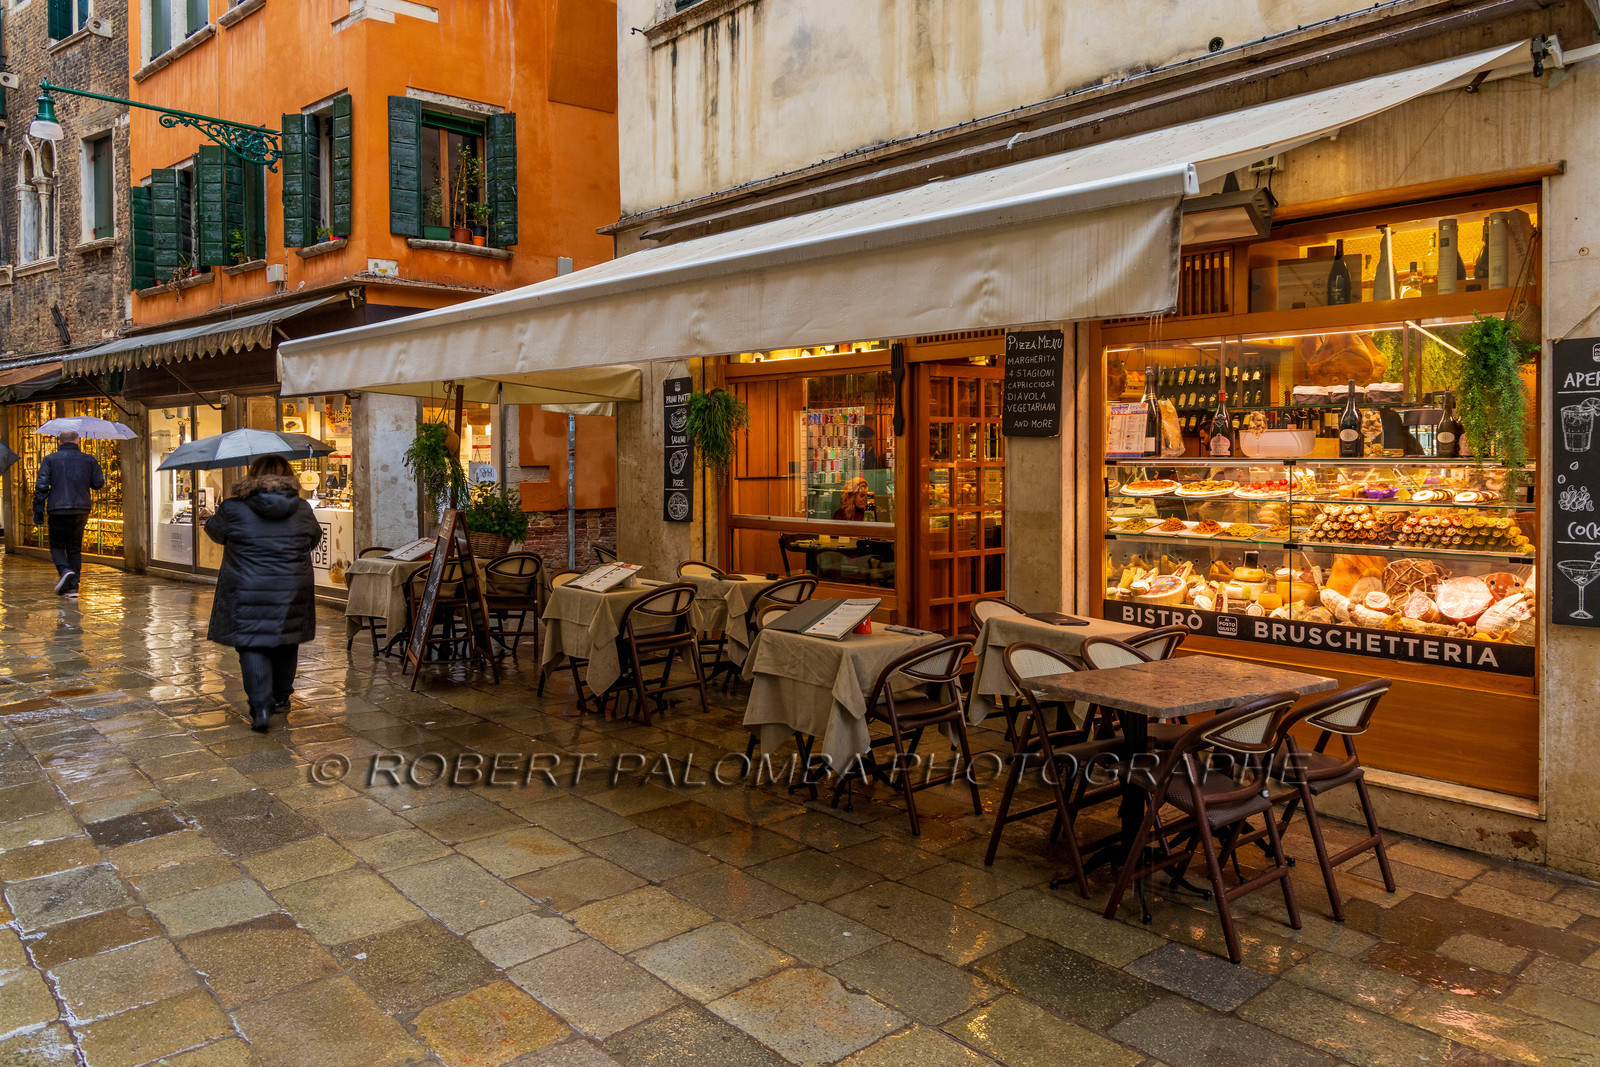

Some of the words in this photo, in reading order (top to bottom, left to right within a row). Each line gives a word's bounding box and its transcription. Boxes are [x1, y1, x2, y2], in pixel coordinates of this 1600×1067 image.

[1007, 354, 1056, 365] MARGHERITA
[1008, 370, 1014, 378] 4
[1016, 367, 1054, 378] STAGIONI
[1008, 381, 1055, 390] CAPRICCIOSA
[1007, 391, 1046, 401] DIAVOLA
[1007, 402, 1056, 413] VEGETARIANA
[1013, 420, 1029, 429] AND
[1031, 419, 1053, 429] MORE
[1122, 605, 1204, 631] BISTRÒ
[1254, 621, 1499, 668] BRUSCHETTERIA
